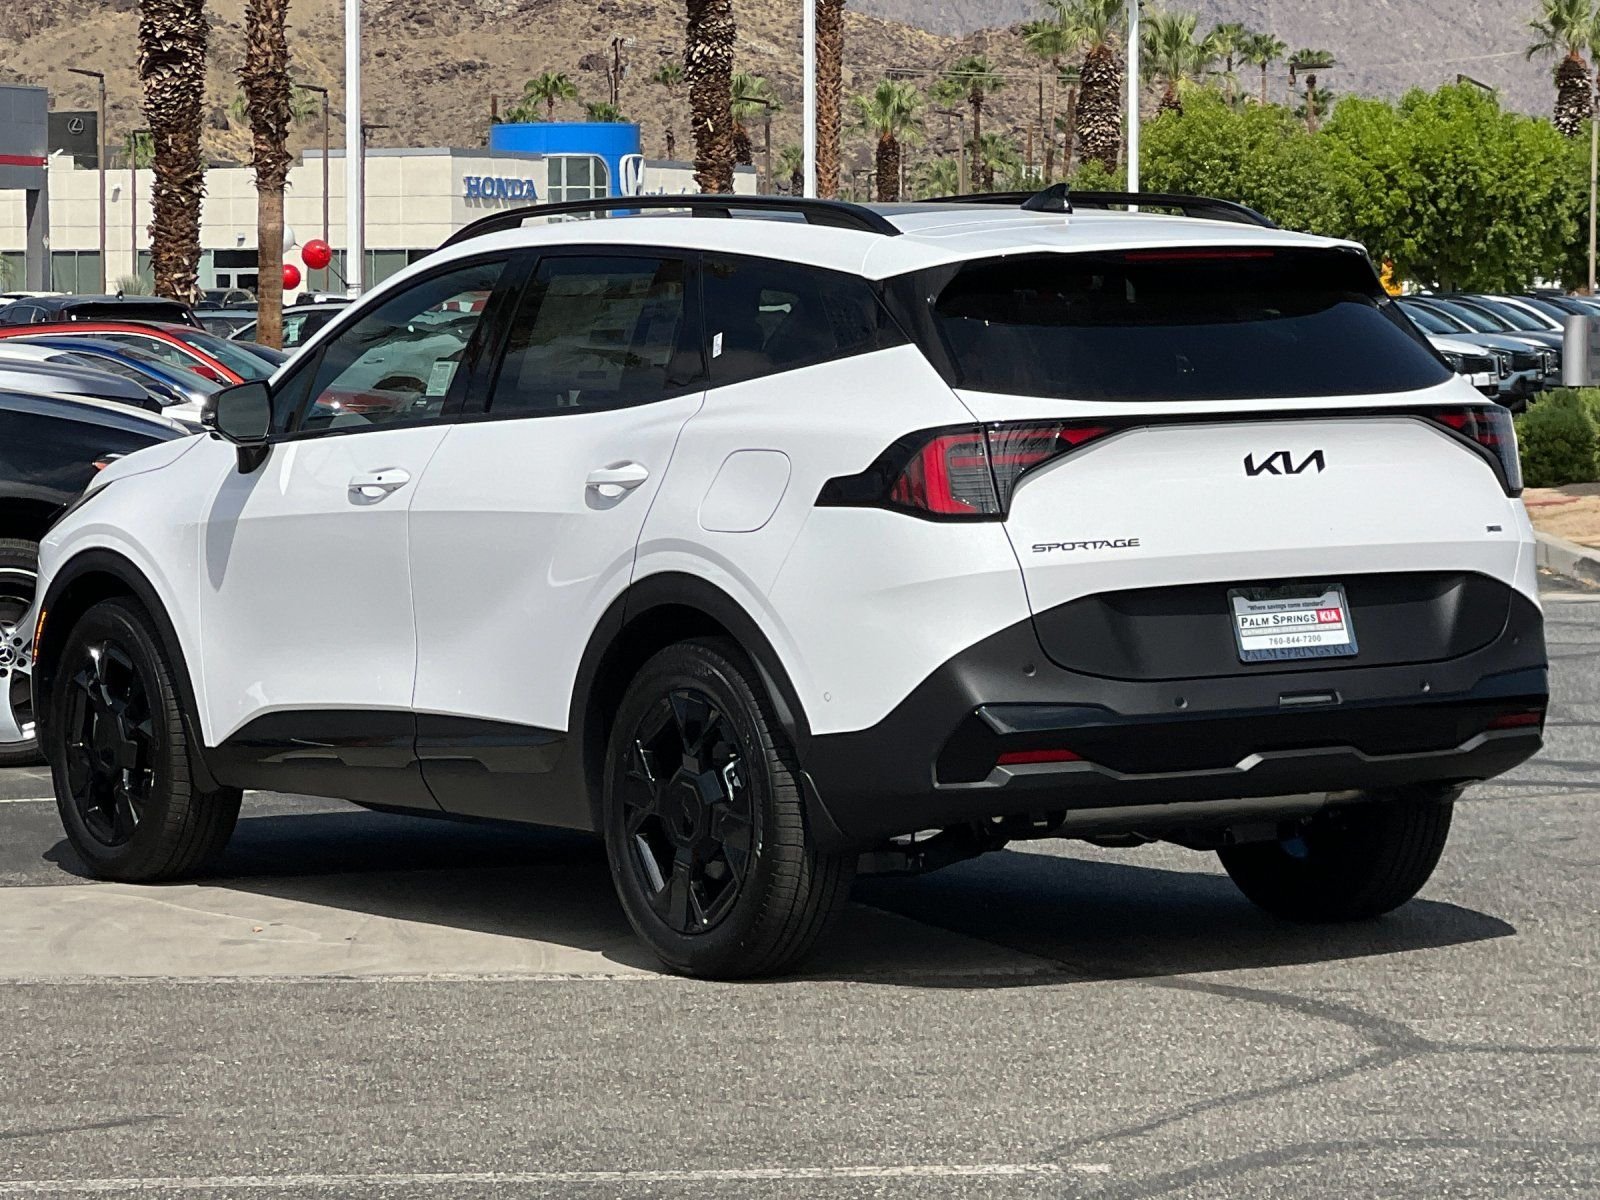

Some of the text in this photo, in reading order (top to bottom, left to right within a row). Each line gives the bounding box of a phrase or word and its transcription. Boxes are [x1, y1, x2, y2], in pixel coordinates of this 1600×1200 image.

[463, 176, 538, 200] HONDA
[1243, 449, 1326, 477] KIA
[1031, 537, 1141, 553] SPORTAGE
[1241, 610, 1339, 627] PALM SPRINGS KIA
[1269, 634, 1321, 645] 760-844-7200
